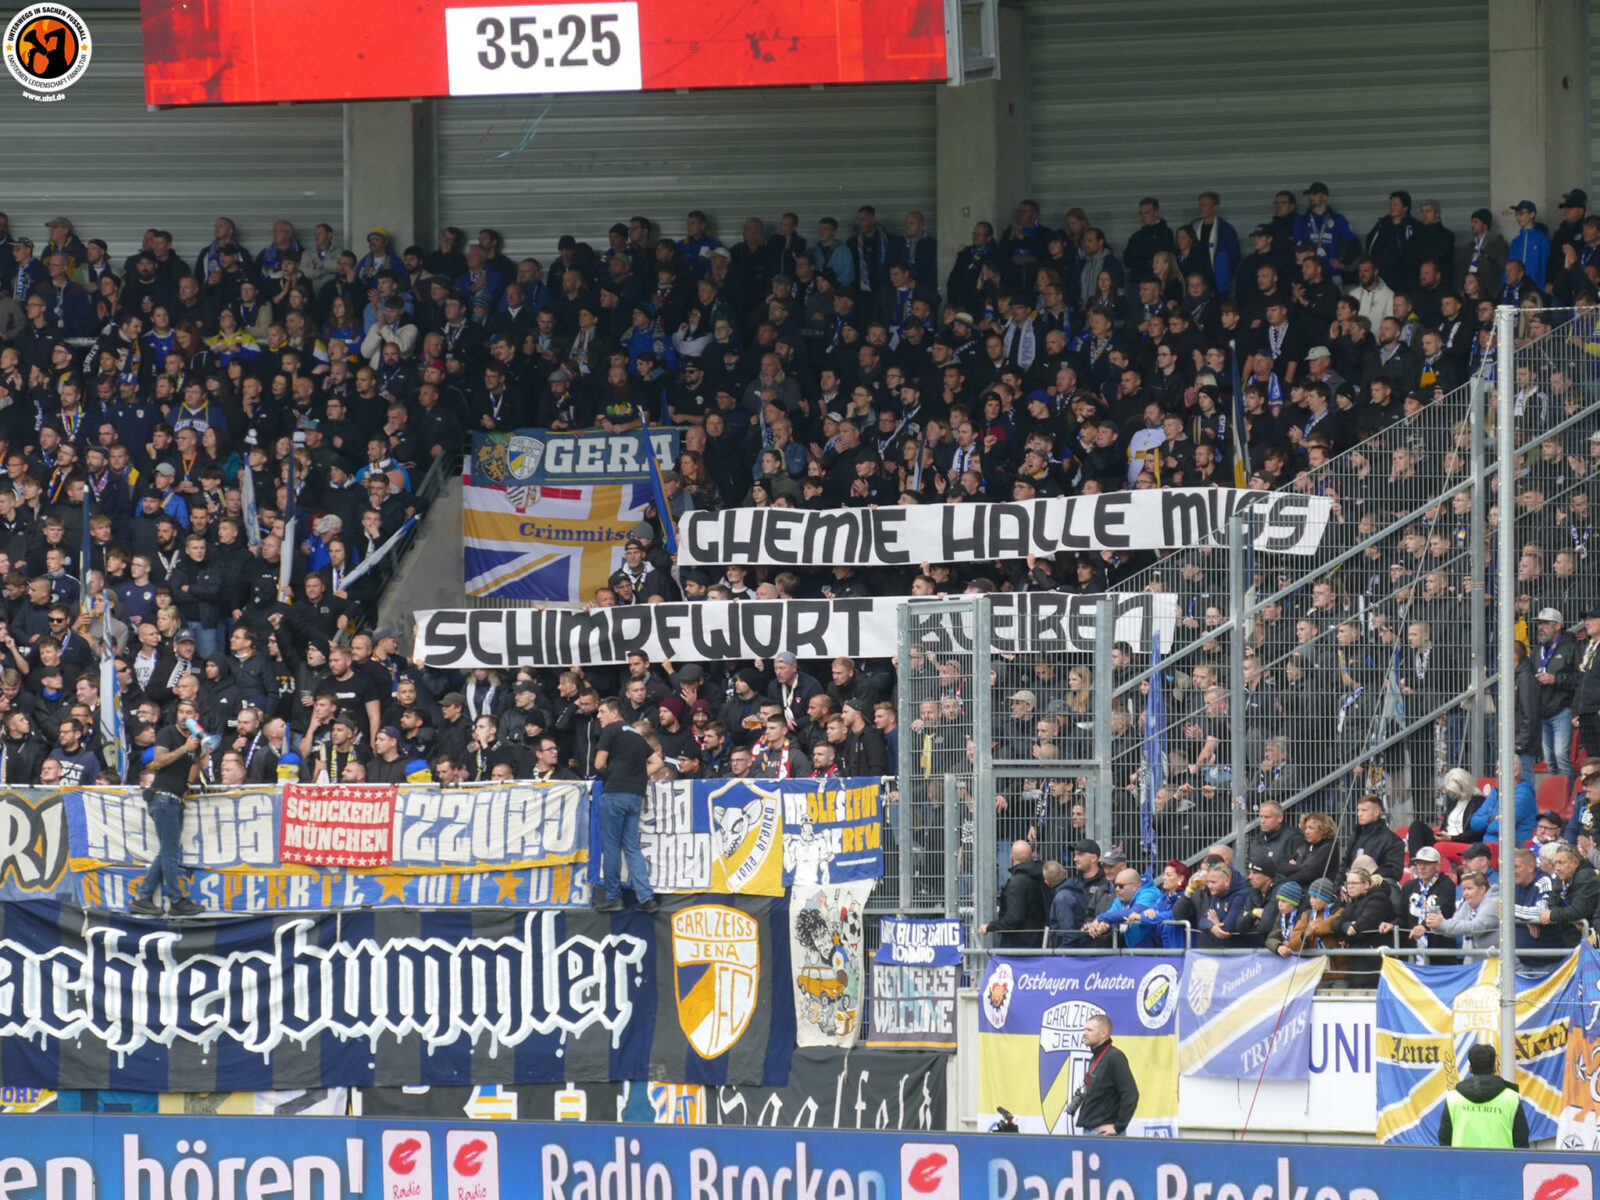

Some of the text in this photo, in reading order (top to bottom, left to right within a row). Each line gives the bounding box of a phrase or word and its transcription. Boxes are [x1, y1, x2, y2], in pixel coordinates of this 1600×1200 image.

[476, 14, 621, 70] 35:25
[544, 434, 675, 474] GERA
[942, 491, 1133, 560] HALLE
[424, 598, 873, 666] SCHIMPFWORT
[286, 796, 390, 825] SCHICKERIA
[393, 784, 581, 863] ZZURO
[284, 823, 388, 852] MÜNCHEN
[529, 866, 590, 905] UNS
[689, 942, 740, 962] JENA
[873, 965, 956, 999] REFUGEES
[1017, 970, 1136, 997] Ostbayern Chaoten
[1221, 961, 1262, 996] Fanklub
[873, 999, 954, 1034] WELCOME
[1240, 1011, 1308, 1074] TRIPTIS
[1309, 1023, 1371, 1074] UNI
[1390, 1035, 1440, 1065] Jena
[1462, 1103, 1502, 1115] SECURITY
[123, 1133, 365, 1200] hören!
[541, 1136, 886, 1200] Radio Brocken
[392, 1181, 421, 1200] Radio
[457, 1184, 487, 1200] Radio
